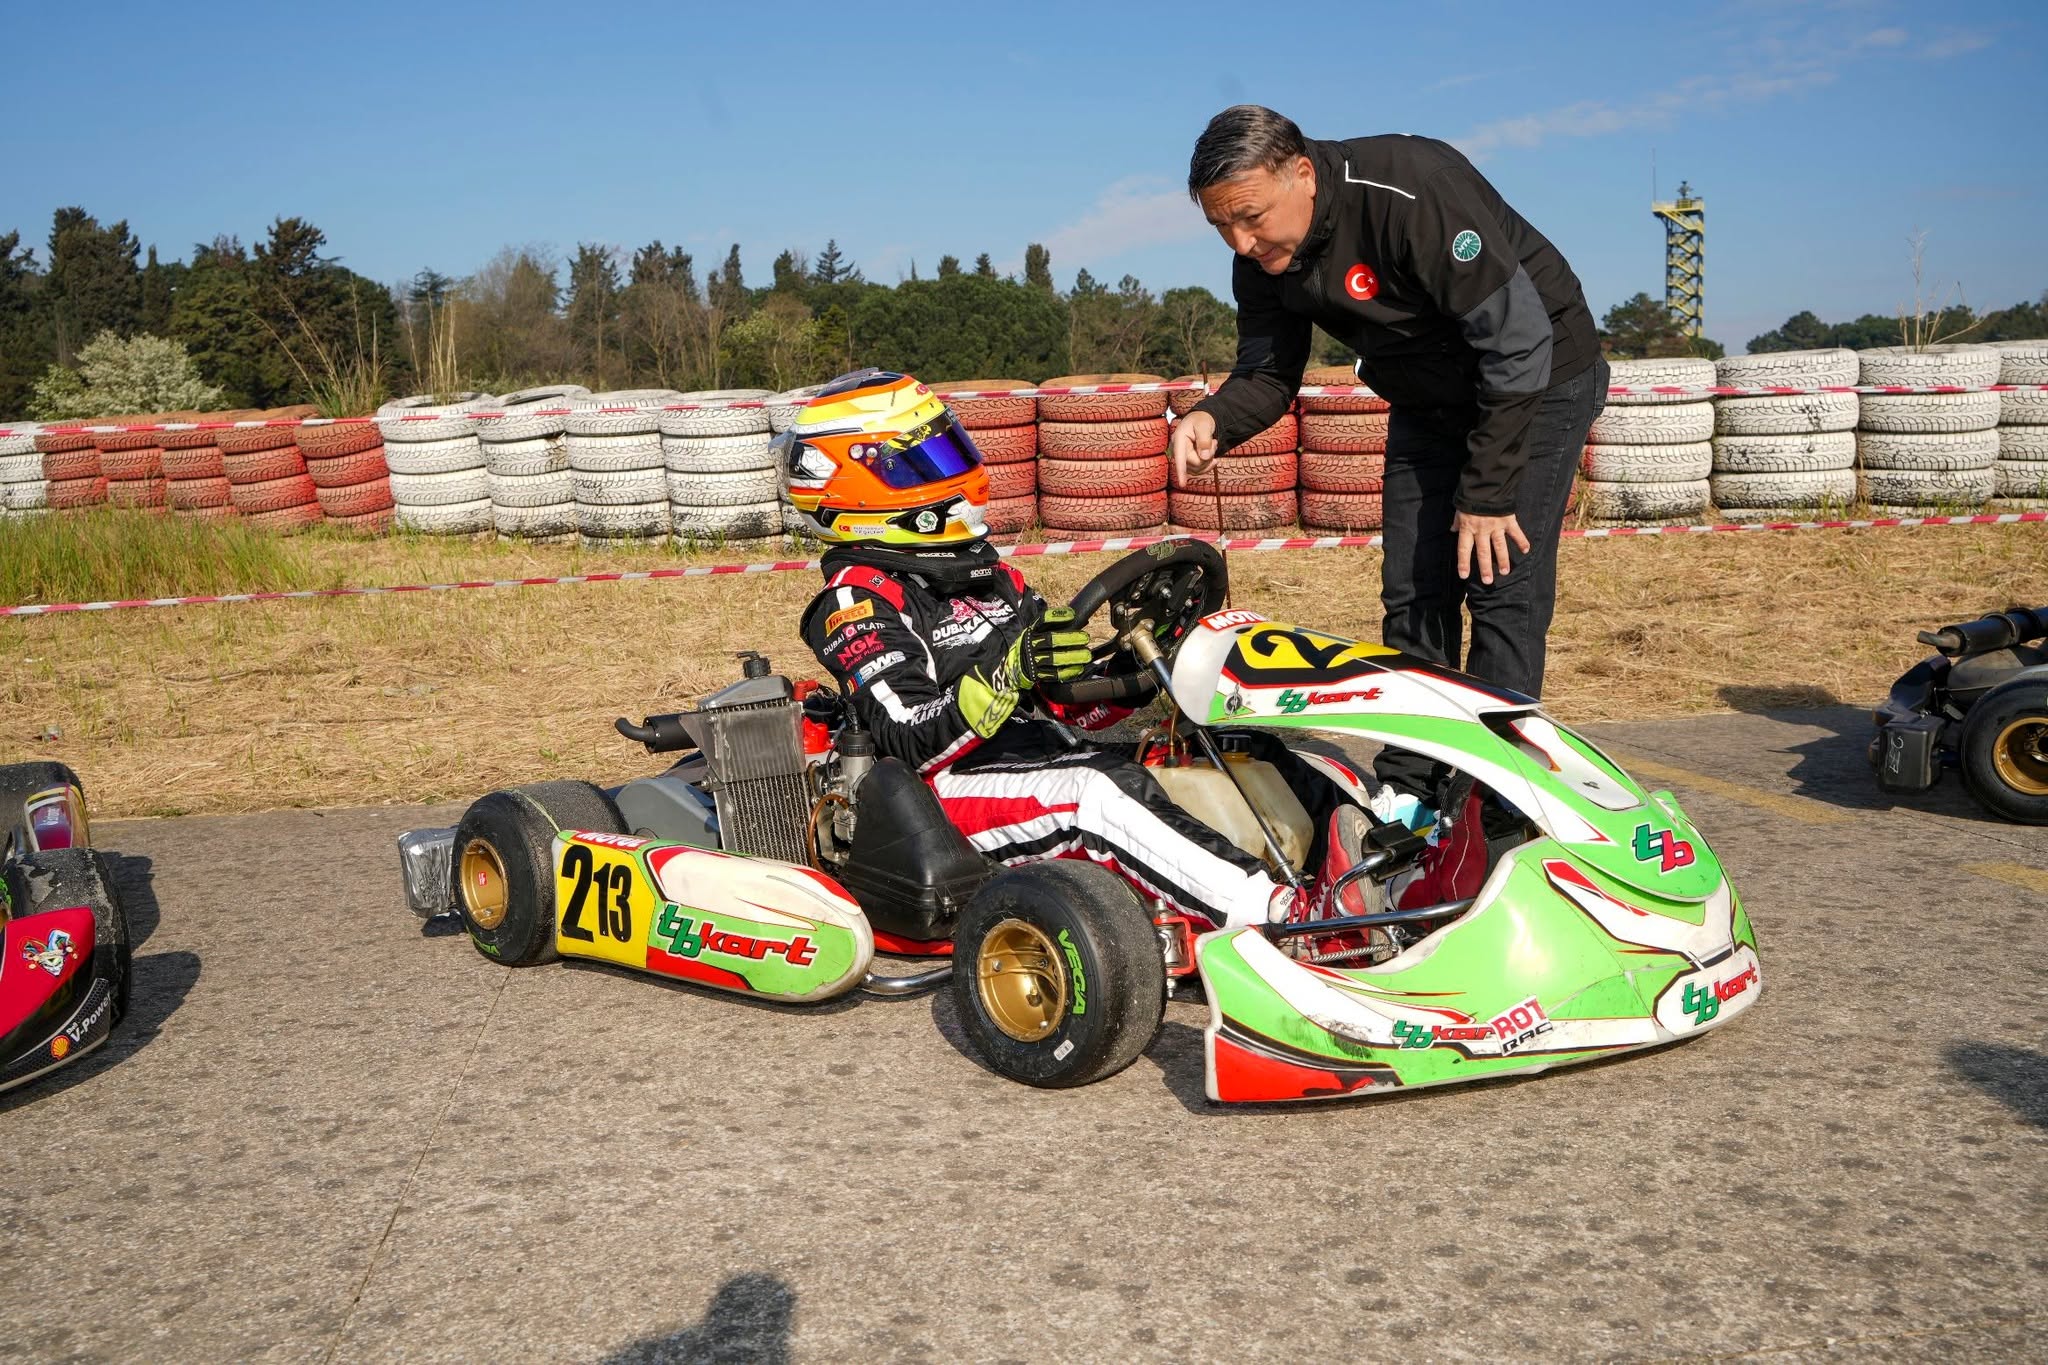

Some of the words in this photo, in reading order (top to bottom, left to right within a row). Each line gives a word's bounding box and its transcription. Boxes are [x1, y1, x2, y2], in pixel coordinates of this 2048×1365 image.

[970, 567, 992, 578] sparco
[822, 633, 846, 656] DUBAI
[837, 631, 881, 665] NGK
[1632, 823, 1696, 872] tb
[561, 844, 632, 943] 213
[657, 904, 818, 967] tbkart
[1057, 928, 1087, 1015] VEGA
[1681, 961, 1759, 1027] tbkart
[1392, 1019, 1498, 1049] tbkar
